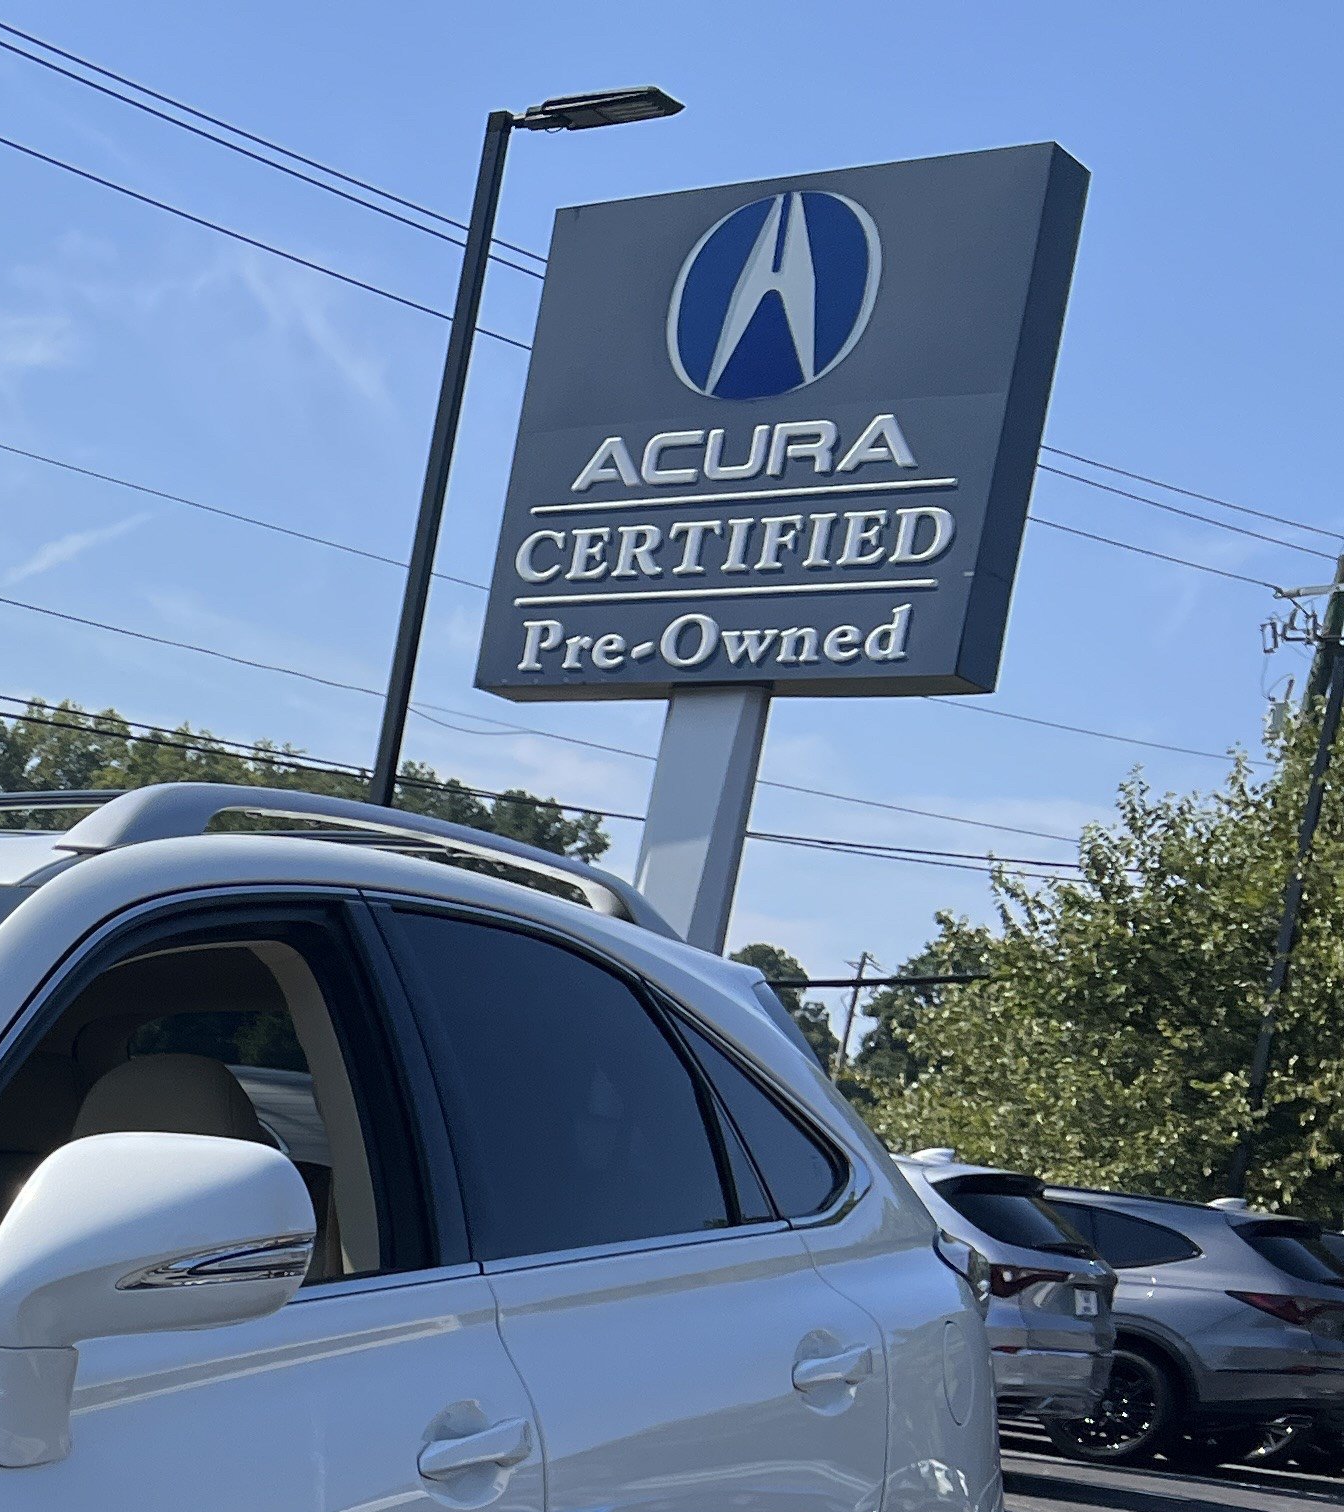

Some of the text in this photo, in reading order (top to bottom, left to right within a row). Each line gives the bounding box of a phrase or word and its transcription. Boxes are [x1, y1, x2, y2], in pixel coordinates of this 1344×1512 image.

[571, 413, 918, 492] ACURA
[514, 505, 953, 586] CERTIFIED
[517, 603, 912, 673] Pre-Owned
